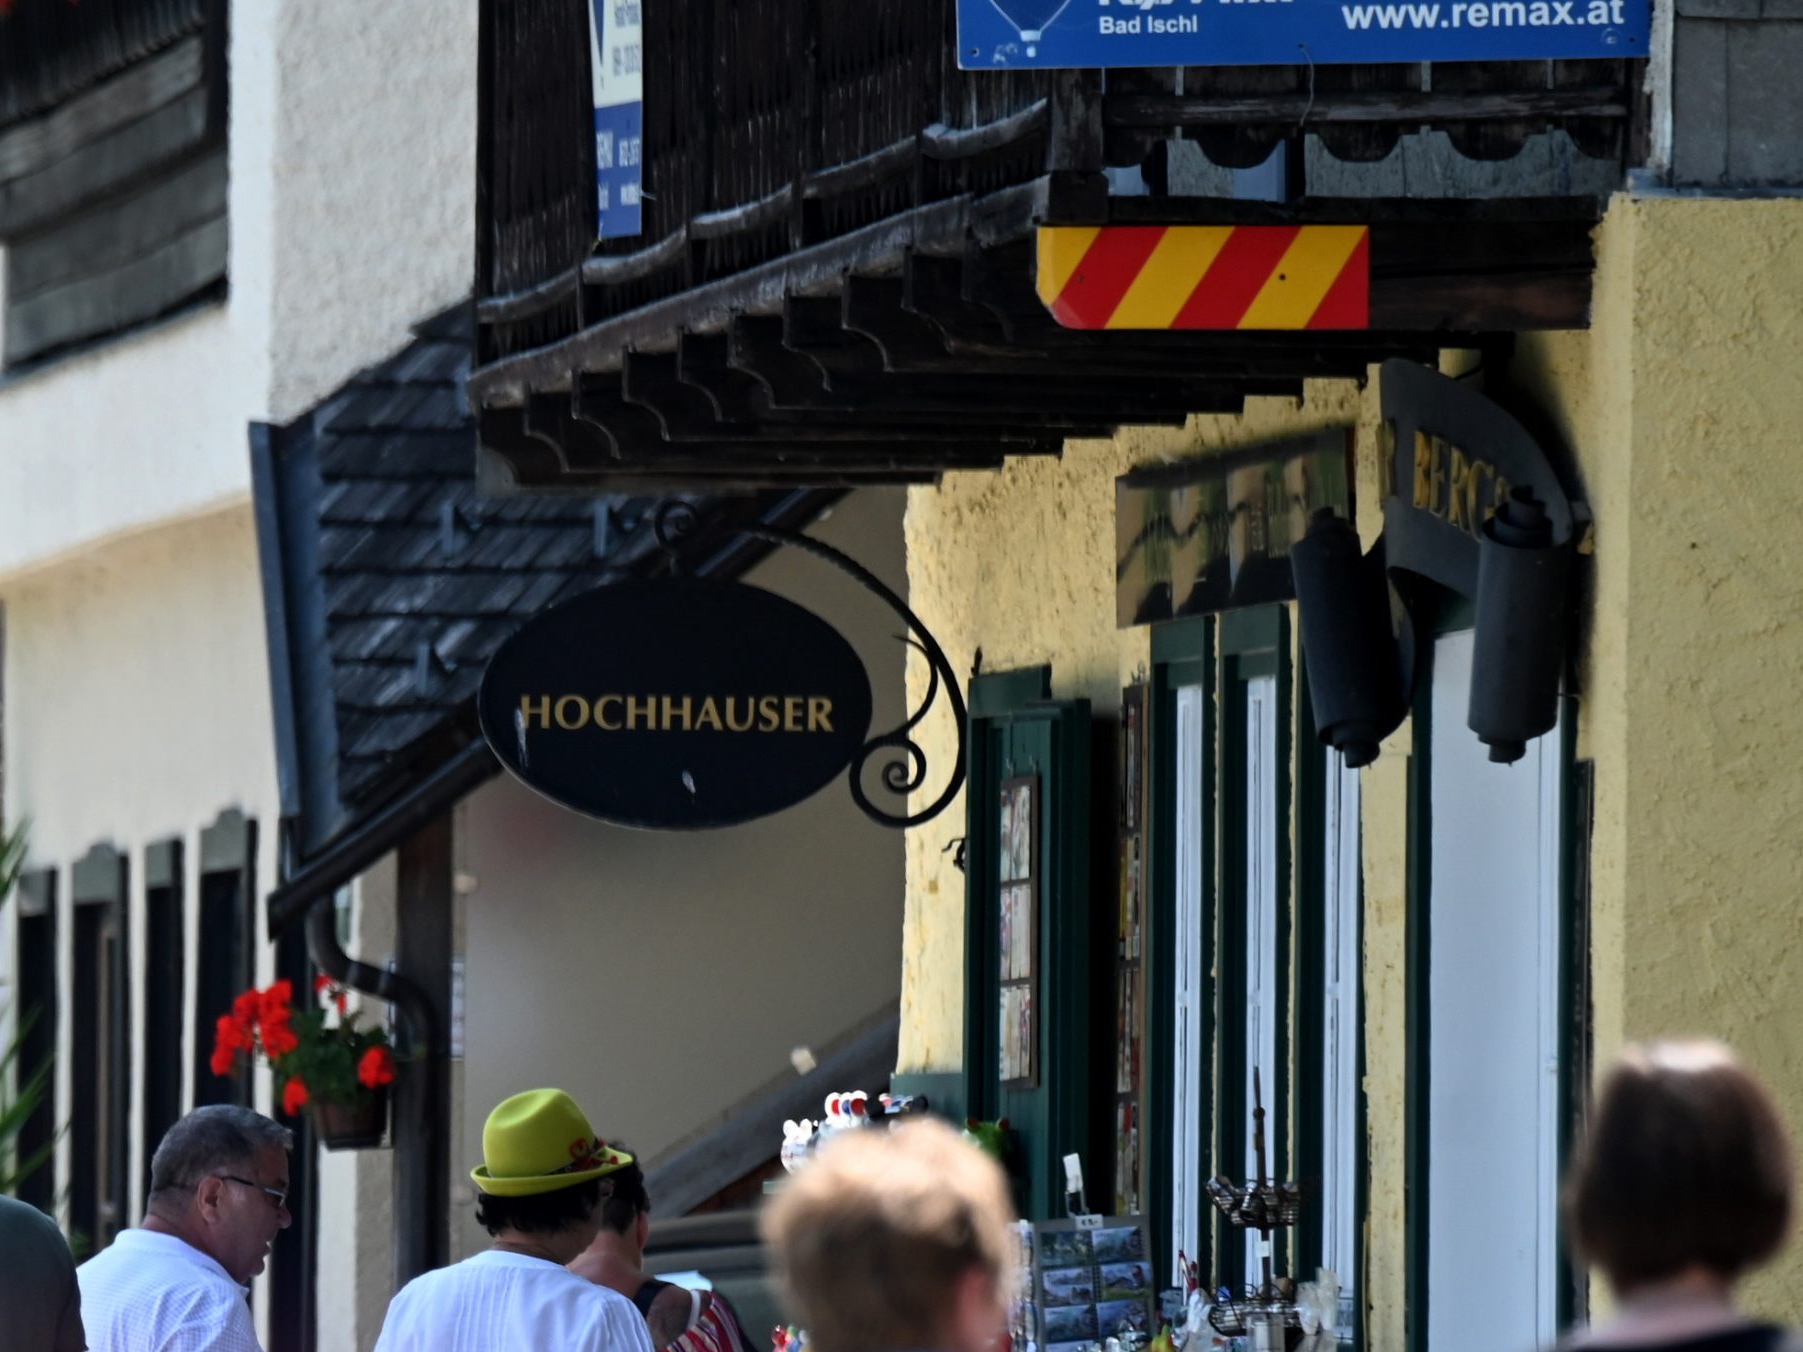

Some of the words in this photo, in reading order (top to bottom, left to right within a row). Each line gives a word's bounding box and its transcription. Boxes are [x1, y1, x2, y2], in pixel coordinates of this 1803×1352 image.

[1099, 16, 1140, 34] Bad
[1147, 14, 1198, 33] Ischl
[1342, 0, 1624, 29] www.remax.at
[520, 695, 834, 732] HOCHHAUSER
